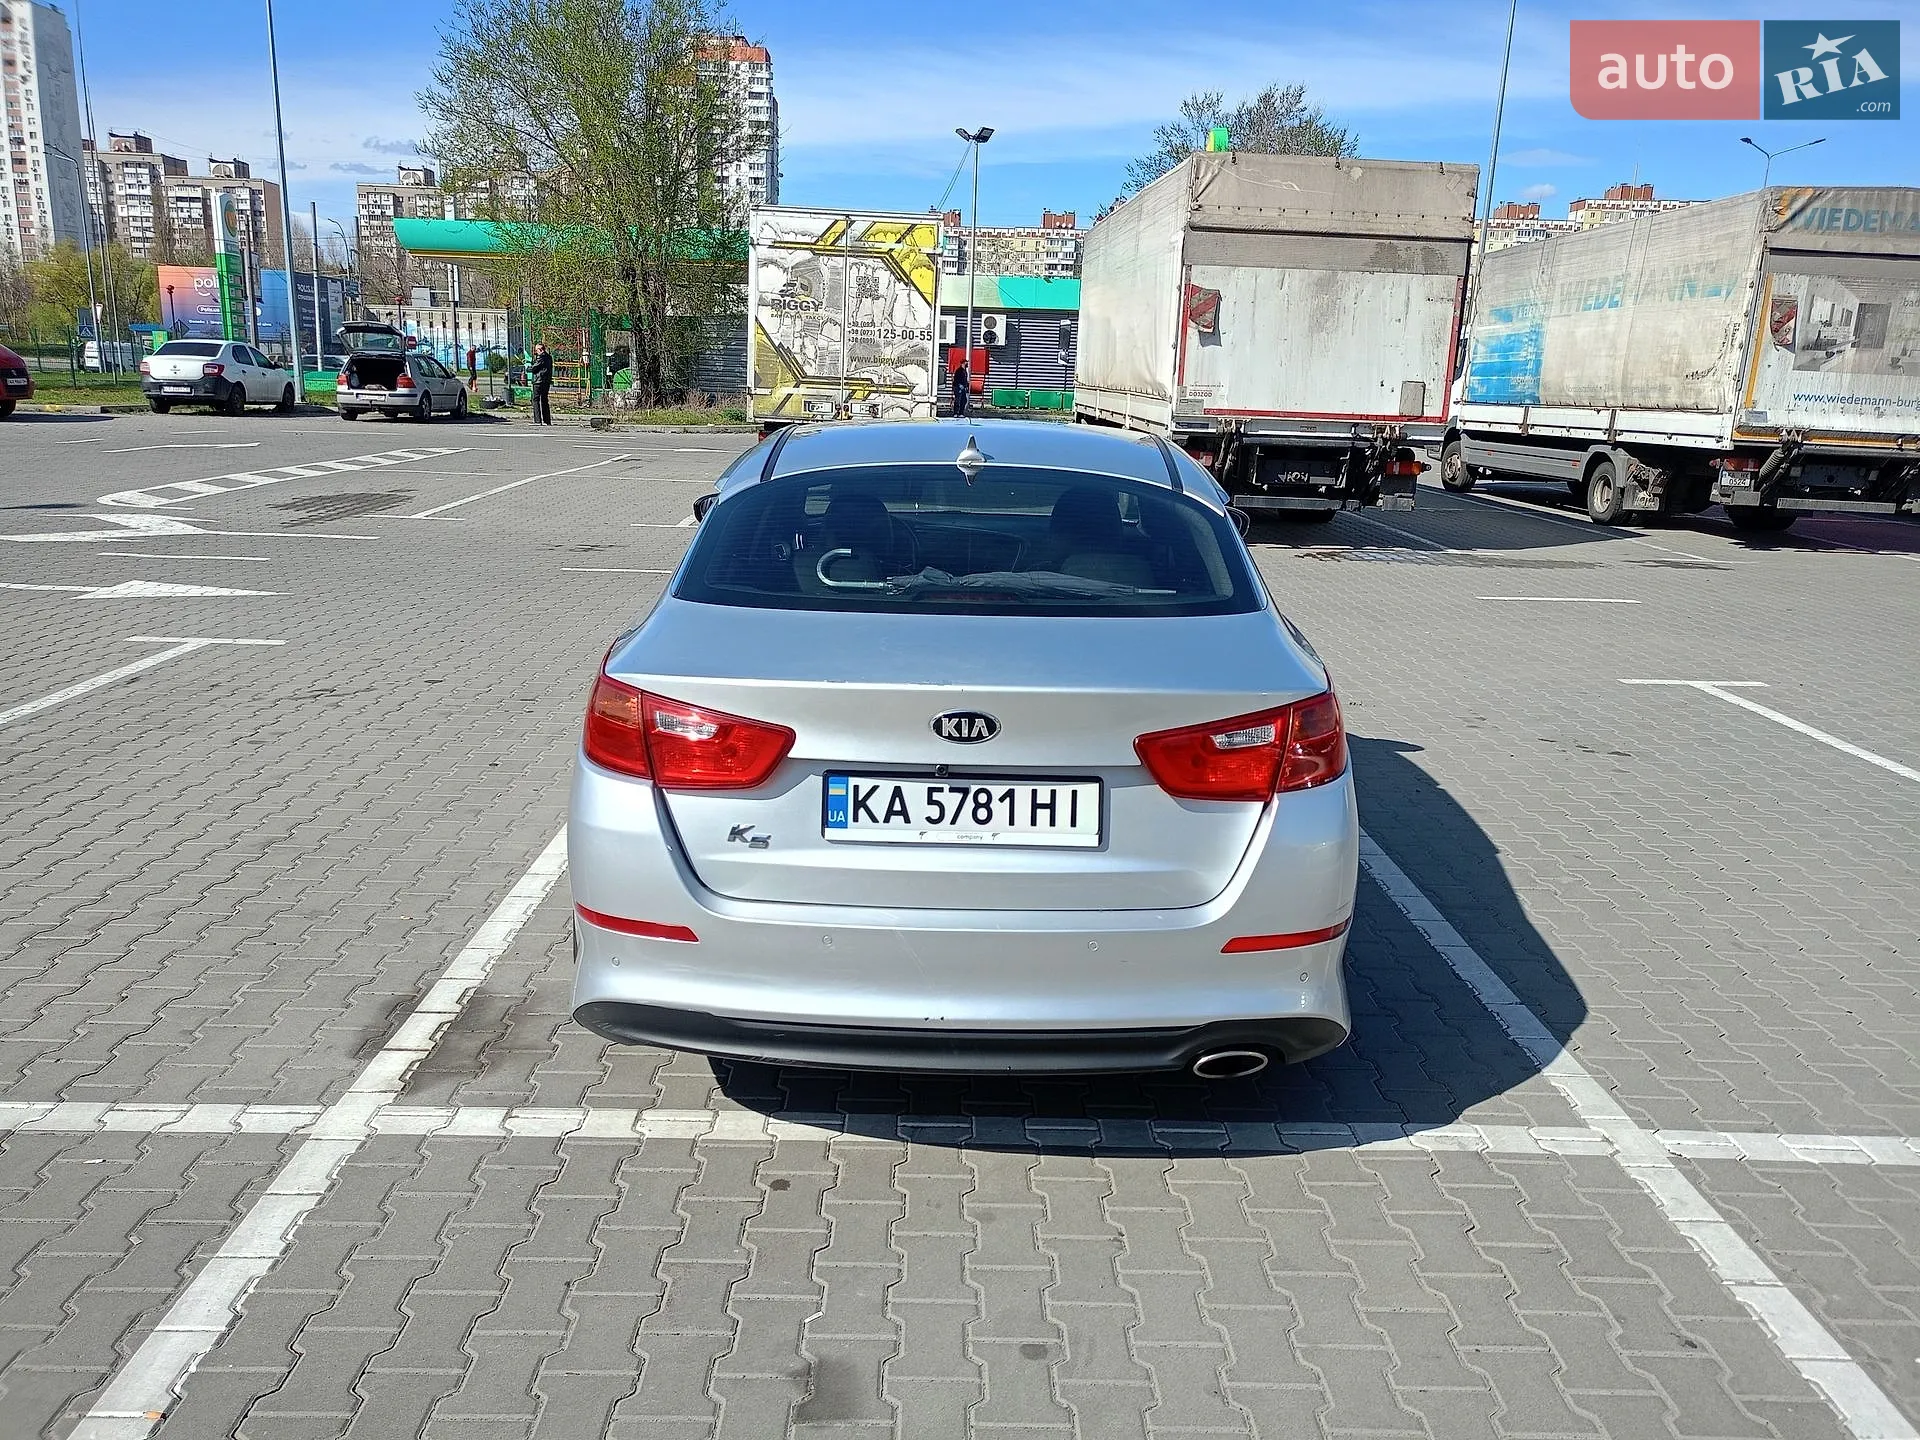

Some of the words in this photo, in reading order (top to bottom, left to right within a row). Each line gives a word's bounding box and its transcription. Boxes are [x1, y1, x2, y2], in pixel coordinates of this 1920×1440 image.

[771, 299, 823, 312] BIGGY
[877, 328, 933, 341] 125-00-55
[940, 717, 990, 738] KIA
[852, 784, 911, 825] KA
[924, 786, 1015, 827] 5781
[1030, 788, 1078, 828] HI
[828, 809, 846, 823] UA
